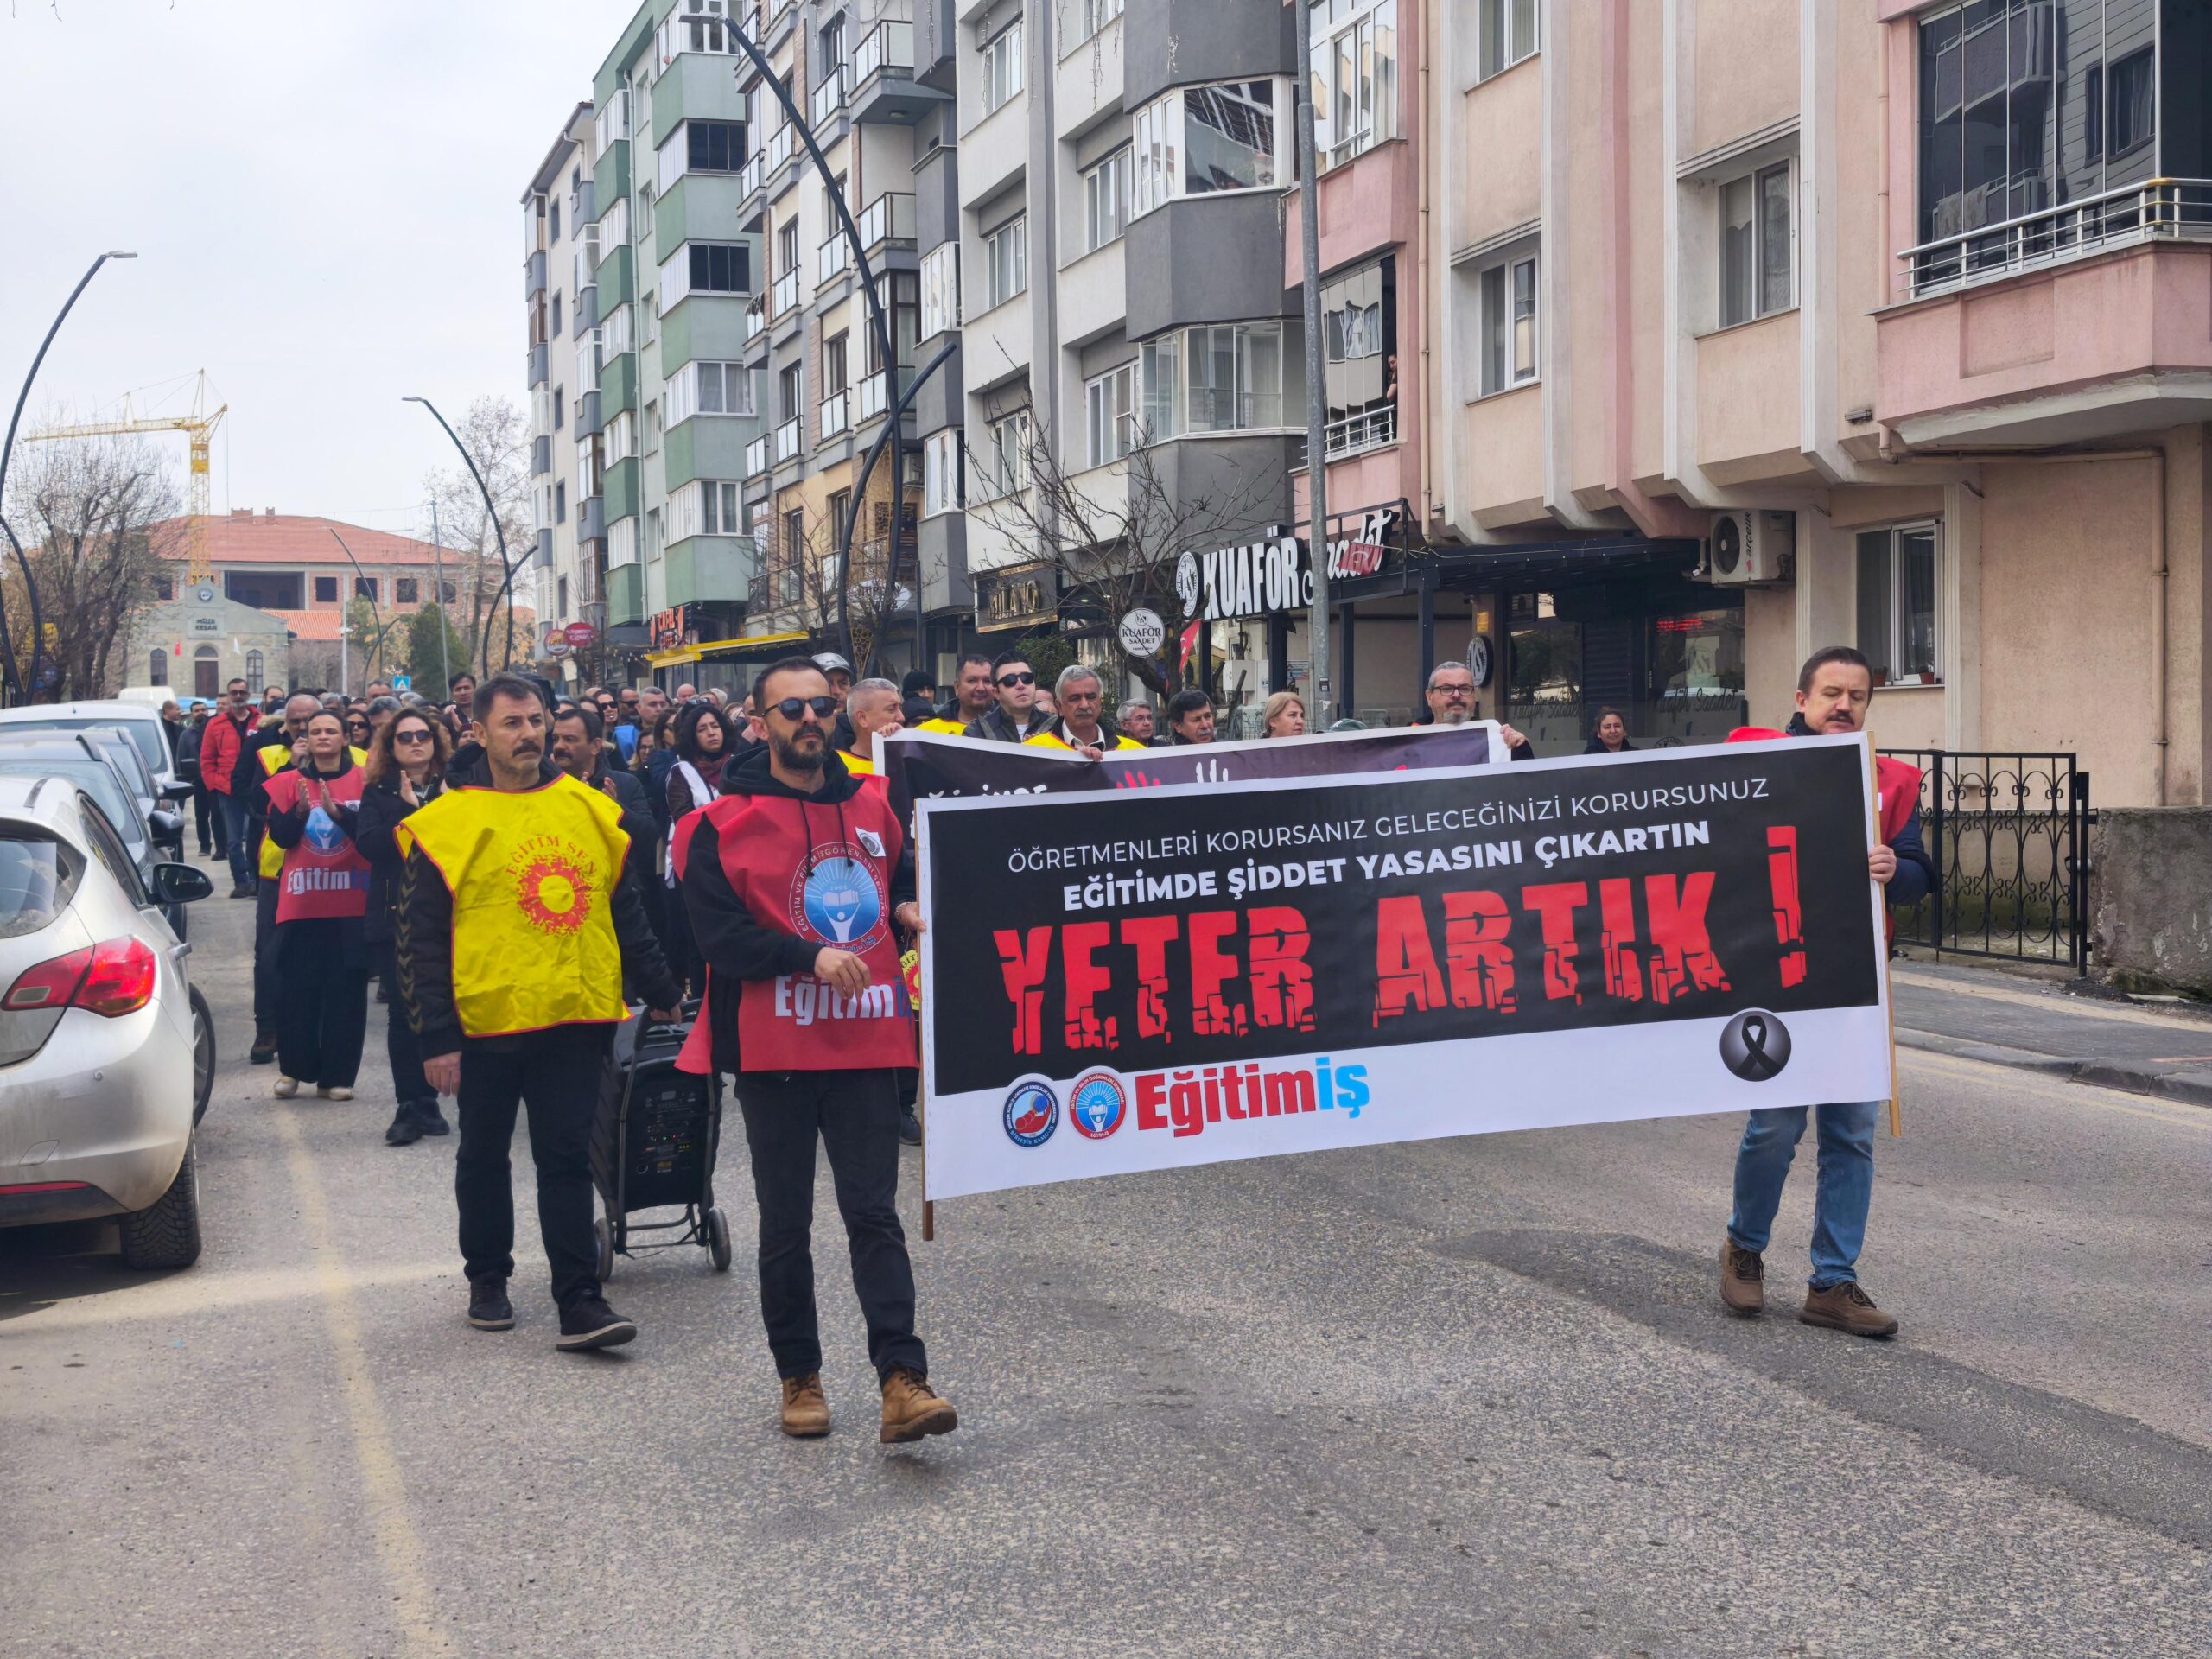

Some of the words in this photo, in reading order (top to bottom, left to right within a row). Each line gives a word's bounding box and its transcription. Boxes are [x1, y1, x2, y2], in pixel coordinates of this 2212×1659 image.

[1203, 524, 1300, 620] KUAFÖR
[1745, 511, 1753, 557] arçelik
[1008, 830, 1198, 873] ÖĞRETMENLERİ
[1206, 820, 1367, 854] KORURSANIZ
[1375, 795, 1560, 836] GELECEĞİNİZİ
[1571, 778, 1769, 817] KORURSUNUZ
[1064, 868, 1217, 912] EĞİTİMDE
[1227, 857, 1347, 900] ŞİDDET
[1356, 840, 1522, 880] YASASINI
[1535, 820, 1710, 868] ÇIKARTIN
[796, 881, 804, 893] VE
[800, 855, 818, 879] BİM
[993, 906, 1317, 1055] YETER
[1372, 871, 1732, 1029] ARTIK
[1766, 825, 1807, 988] !
